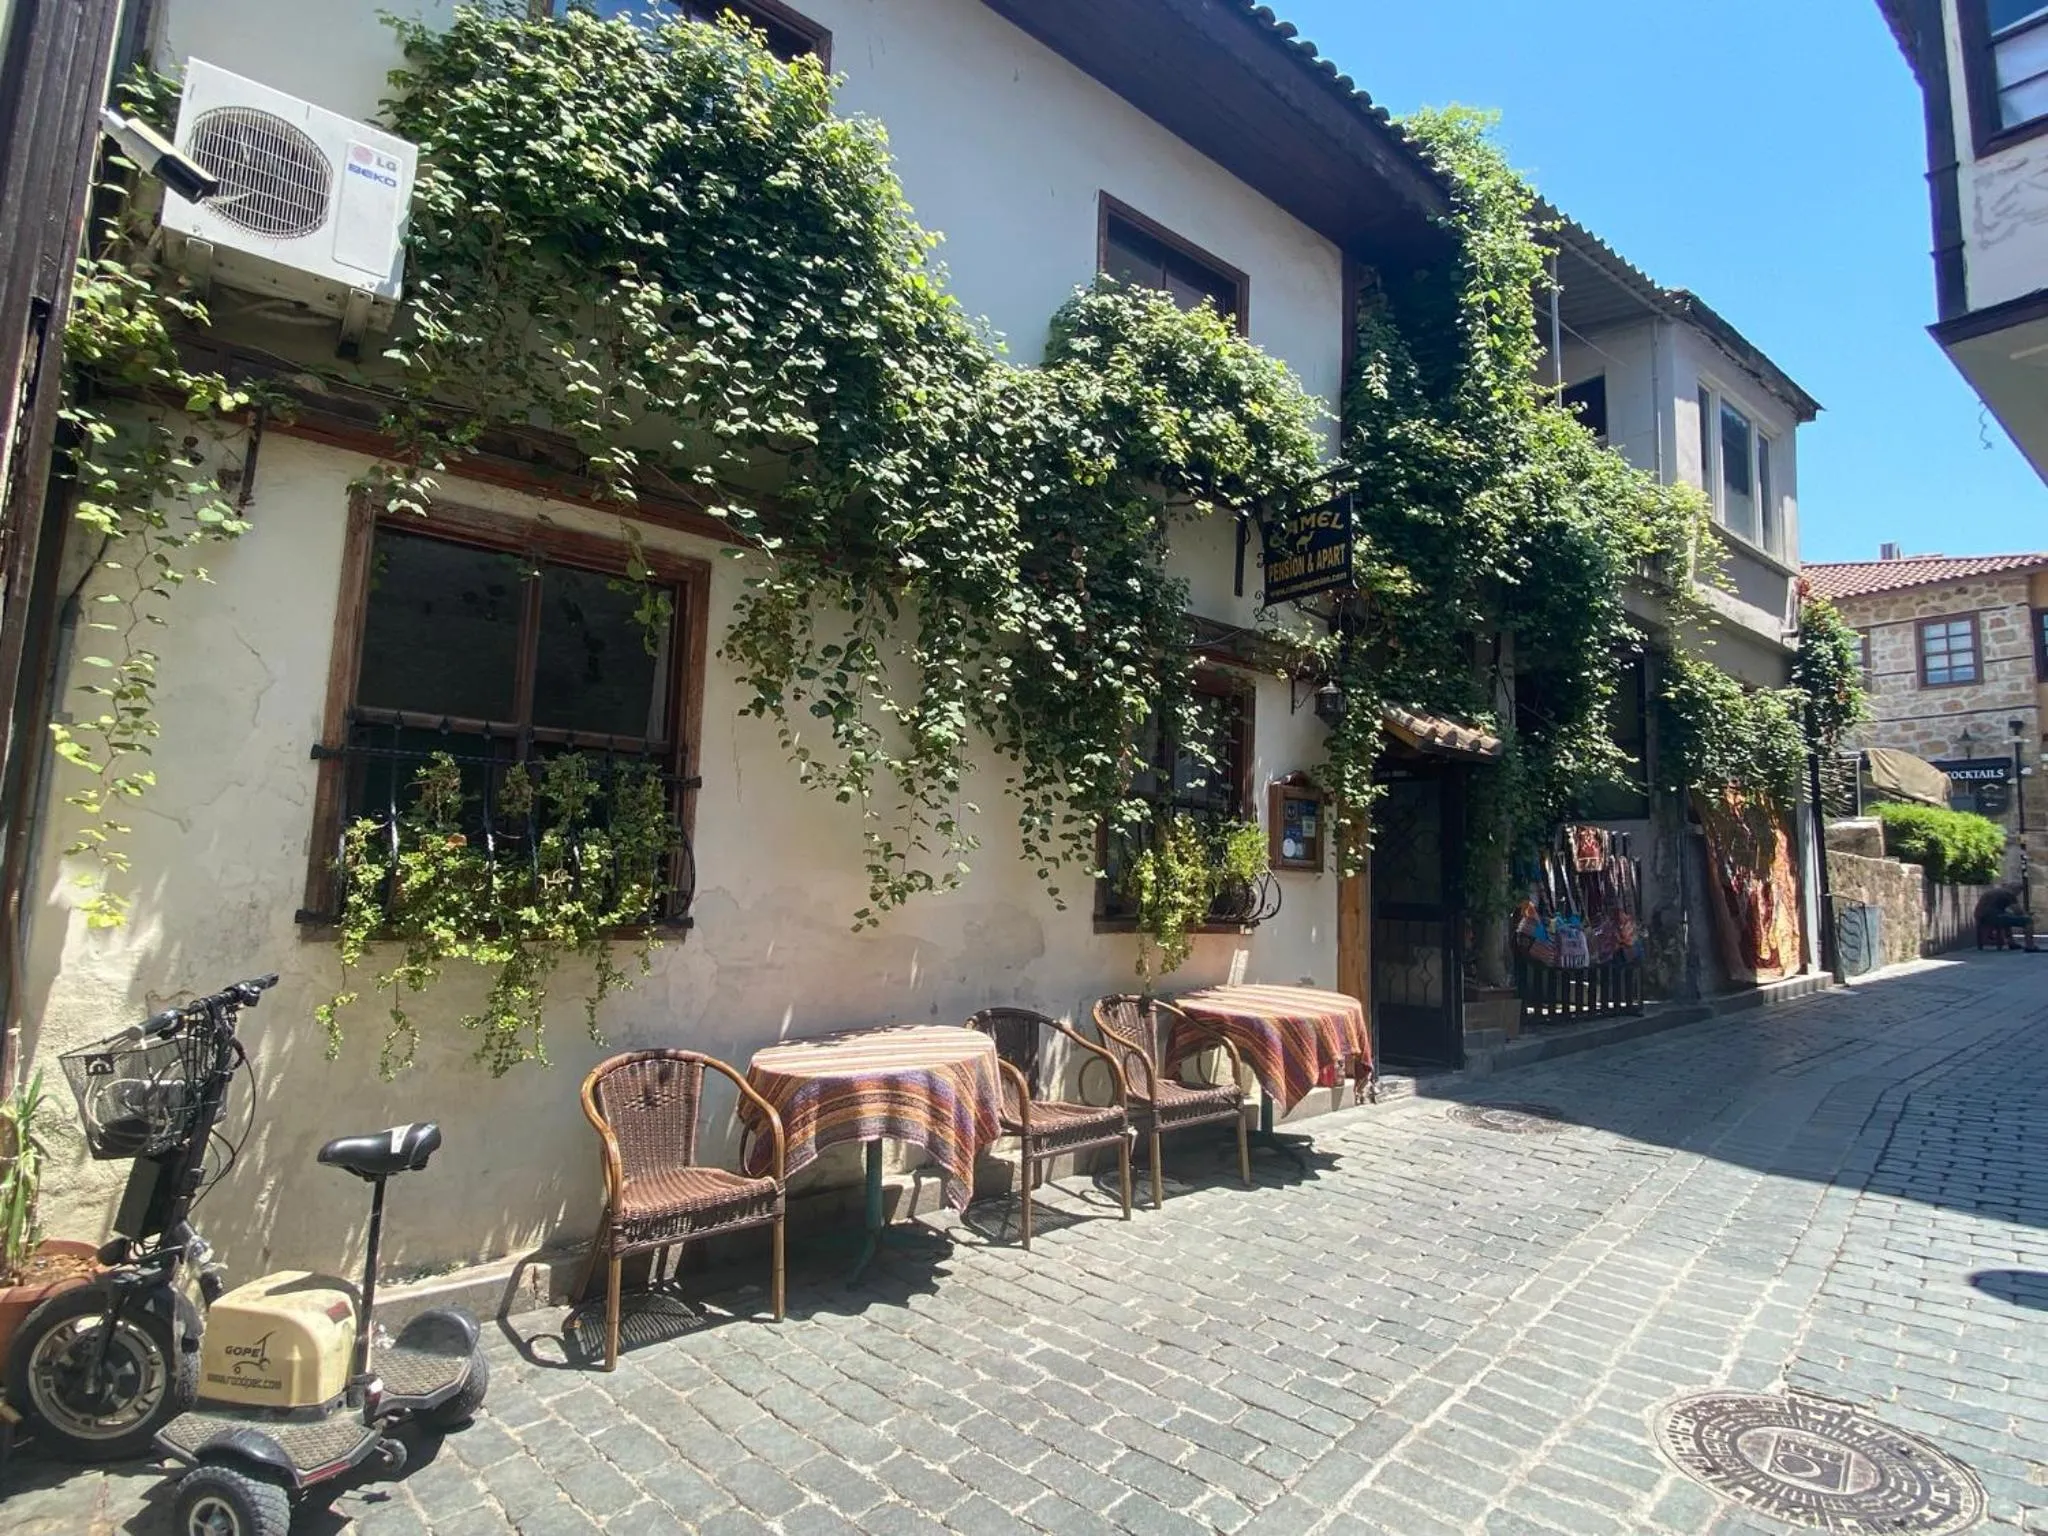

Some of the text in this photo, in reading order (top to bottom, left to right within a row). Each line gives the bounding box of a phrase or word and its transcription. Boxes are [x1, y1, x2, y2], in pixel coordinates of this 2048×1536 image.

[376, 157, 397, 172] LG
[1268, 543, 1346, 583] PENSION & APART
